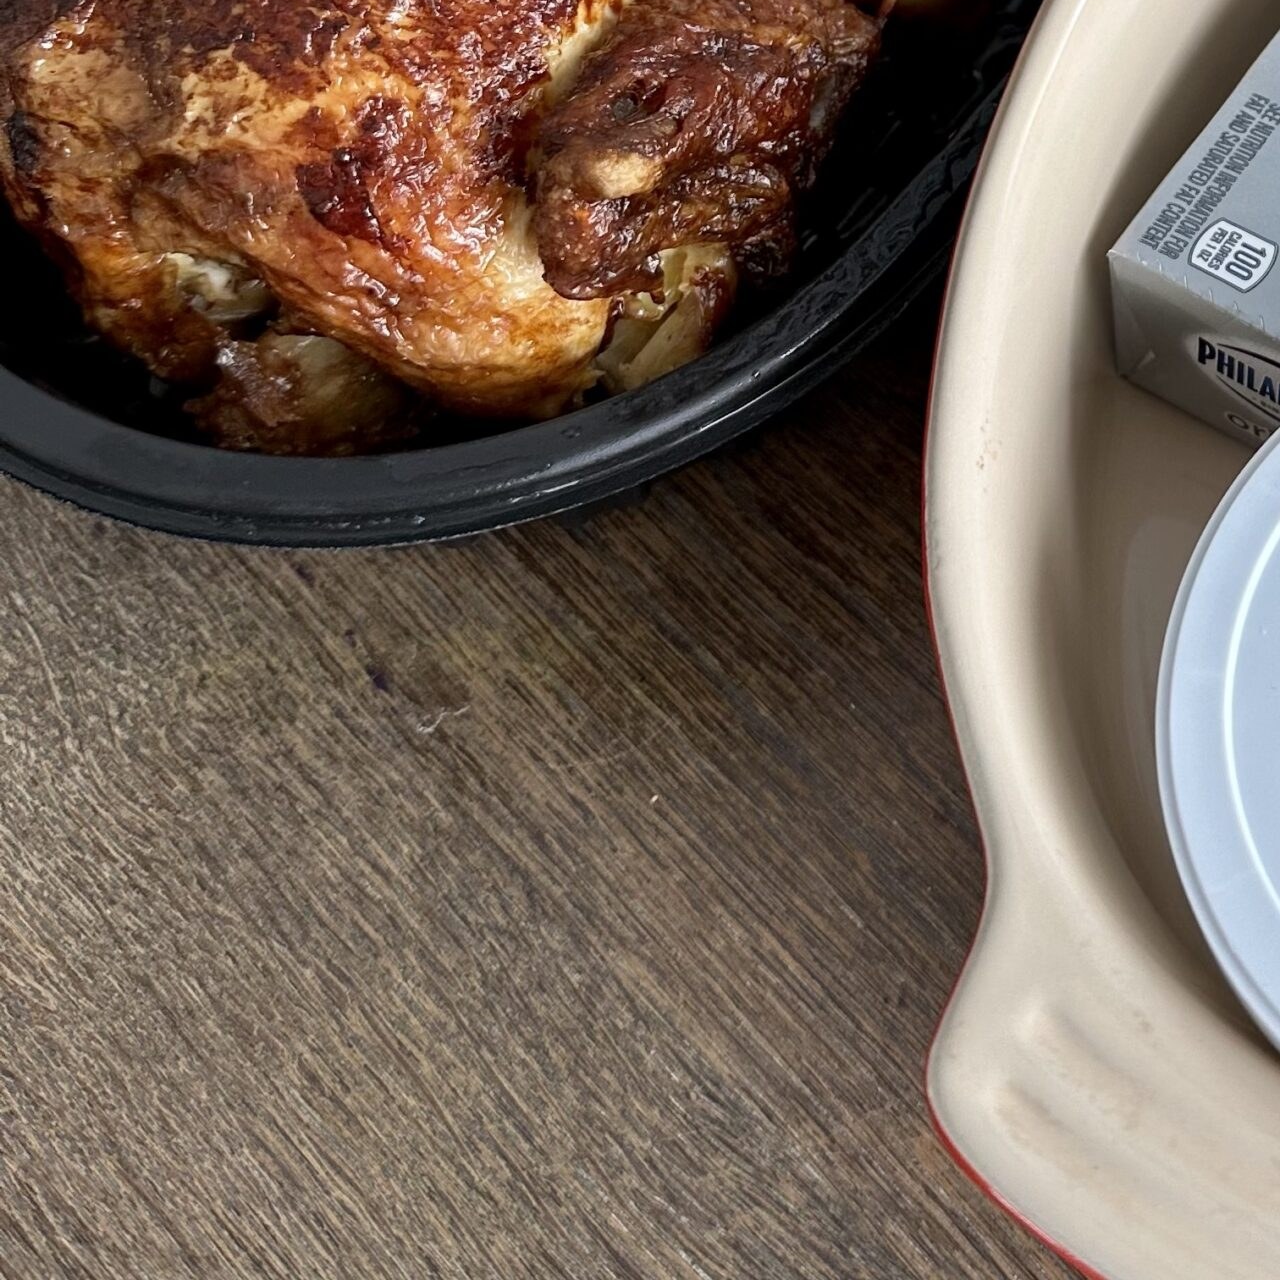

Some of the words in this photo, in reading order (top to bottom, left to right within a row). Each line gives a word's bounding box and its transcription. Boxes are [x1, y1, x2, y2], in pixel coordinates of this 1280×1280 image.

[1243, 92, 1271, 115] FAT
[1228, 109, 1257, 134] AND
[1187, 130, 1241, 187] SATURATED
[1223, 120, 1276, 175] NUTRITION
[1173, 183, 1201, 206] FAT
[1174, 169, 1239, 240] INFORMATION
[1138, 201, 1187, 250] CONTENT
[1210, 226, 1229, 244] PER
[1157, 233, 1189, 260] FOR
[1196, 248, 1212, 262] OZ
[1206, 242, 1217, 250] 1
[1207, 230, 1243, 270] CALORIES
[1224, 241, 1267, 281] 100
